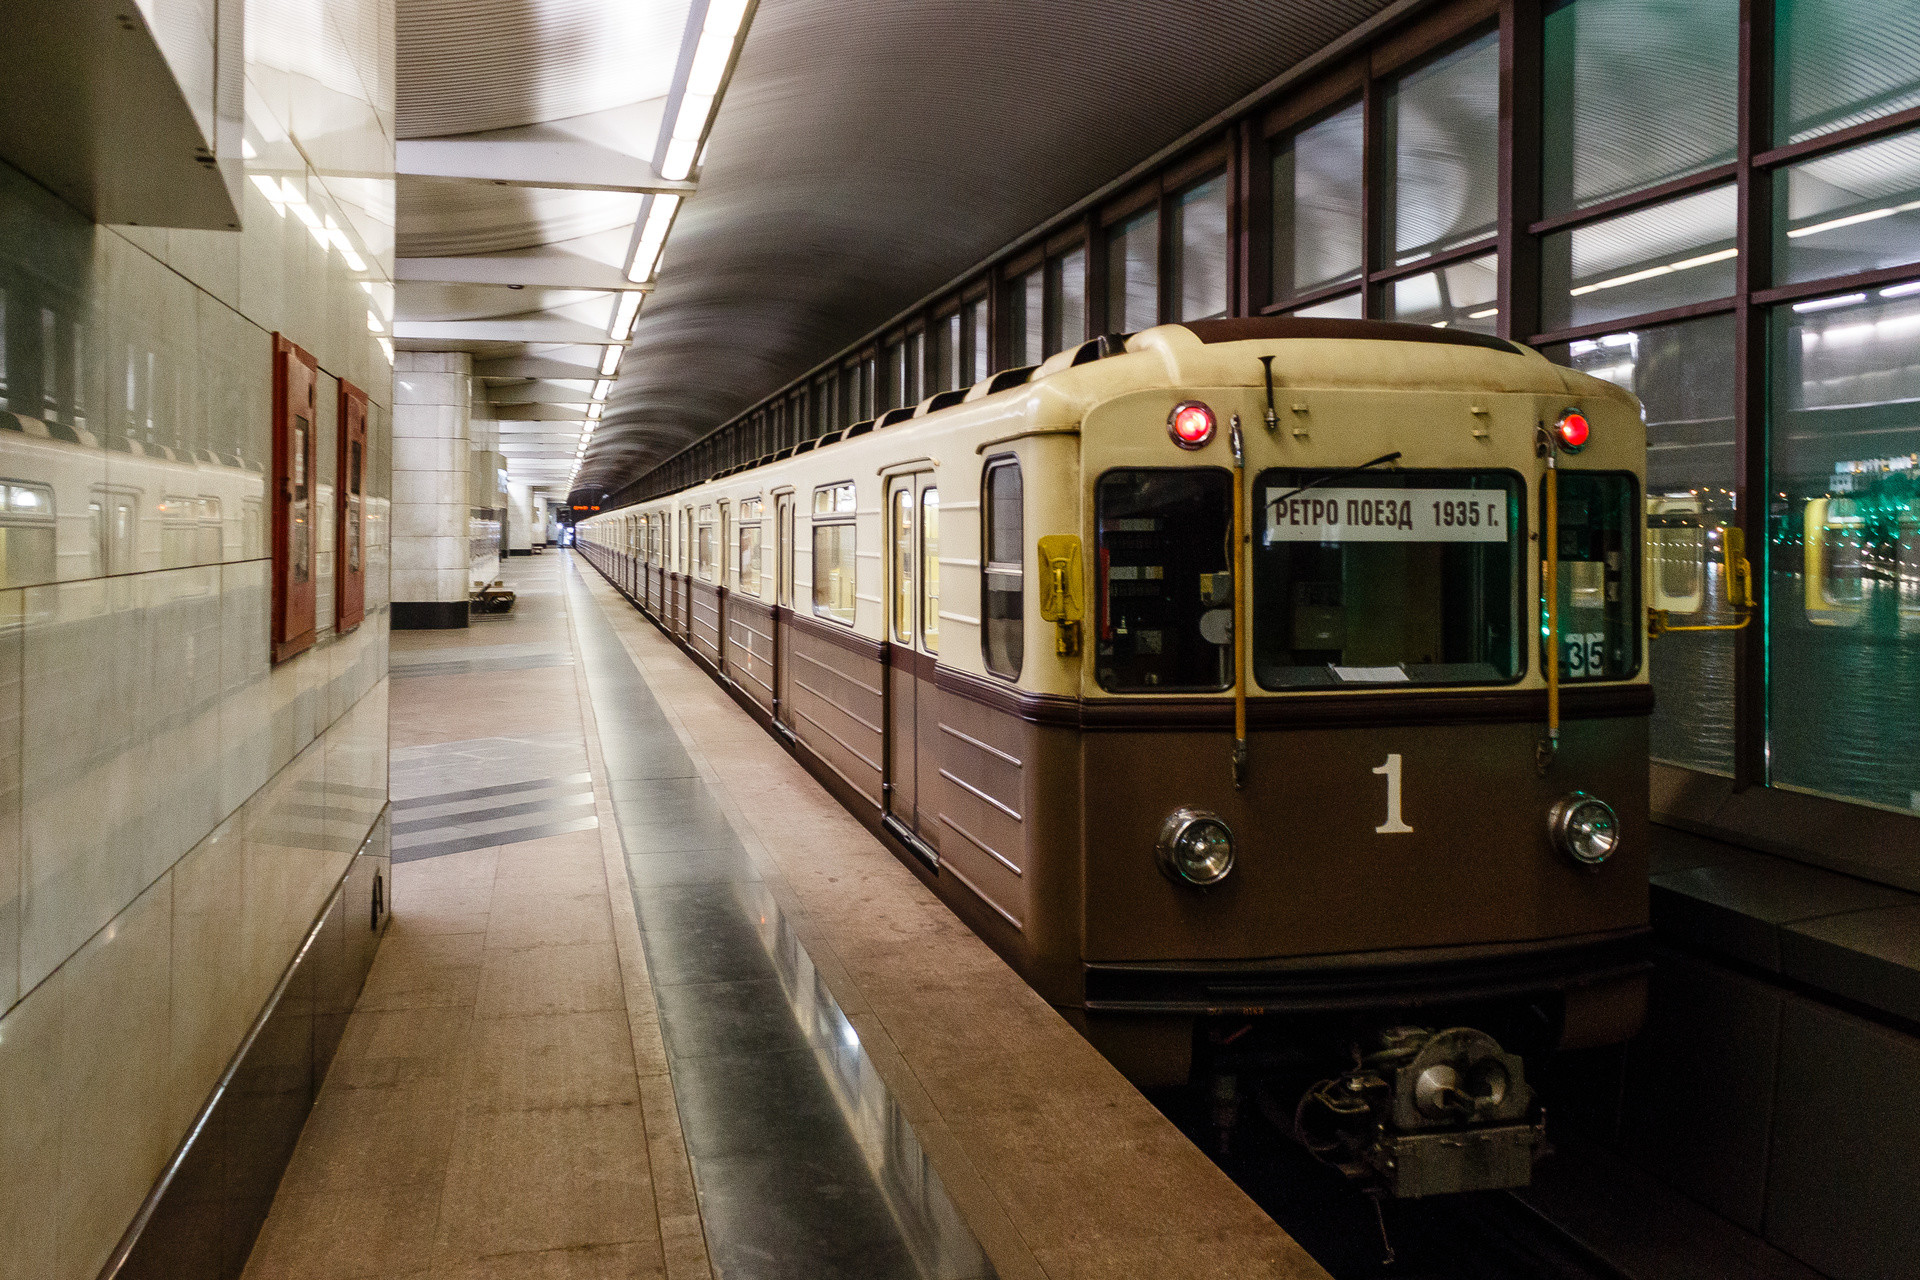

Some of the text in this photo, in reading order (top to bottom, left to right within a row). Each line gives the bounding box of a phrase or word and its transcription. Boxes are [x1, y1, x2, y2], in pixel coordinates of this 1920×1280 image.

[1275, 499, 1339, 526] РЕТРО
[1346, 499, 1413, 531] ПОЕЗД
[1432, 501, 1480, 527] 1935
[1566, 641, 1604, 670] 35
[1372, 753, 1414, 834] 1
